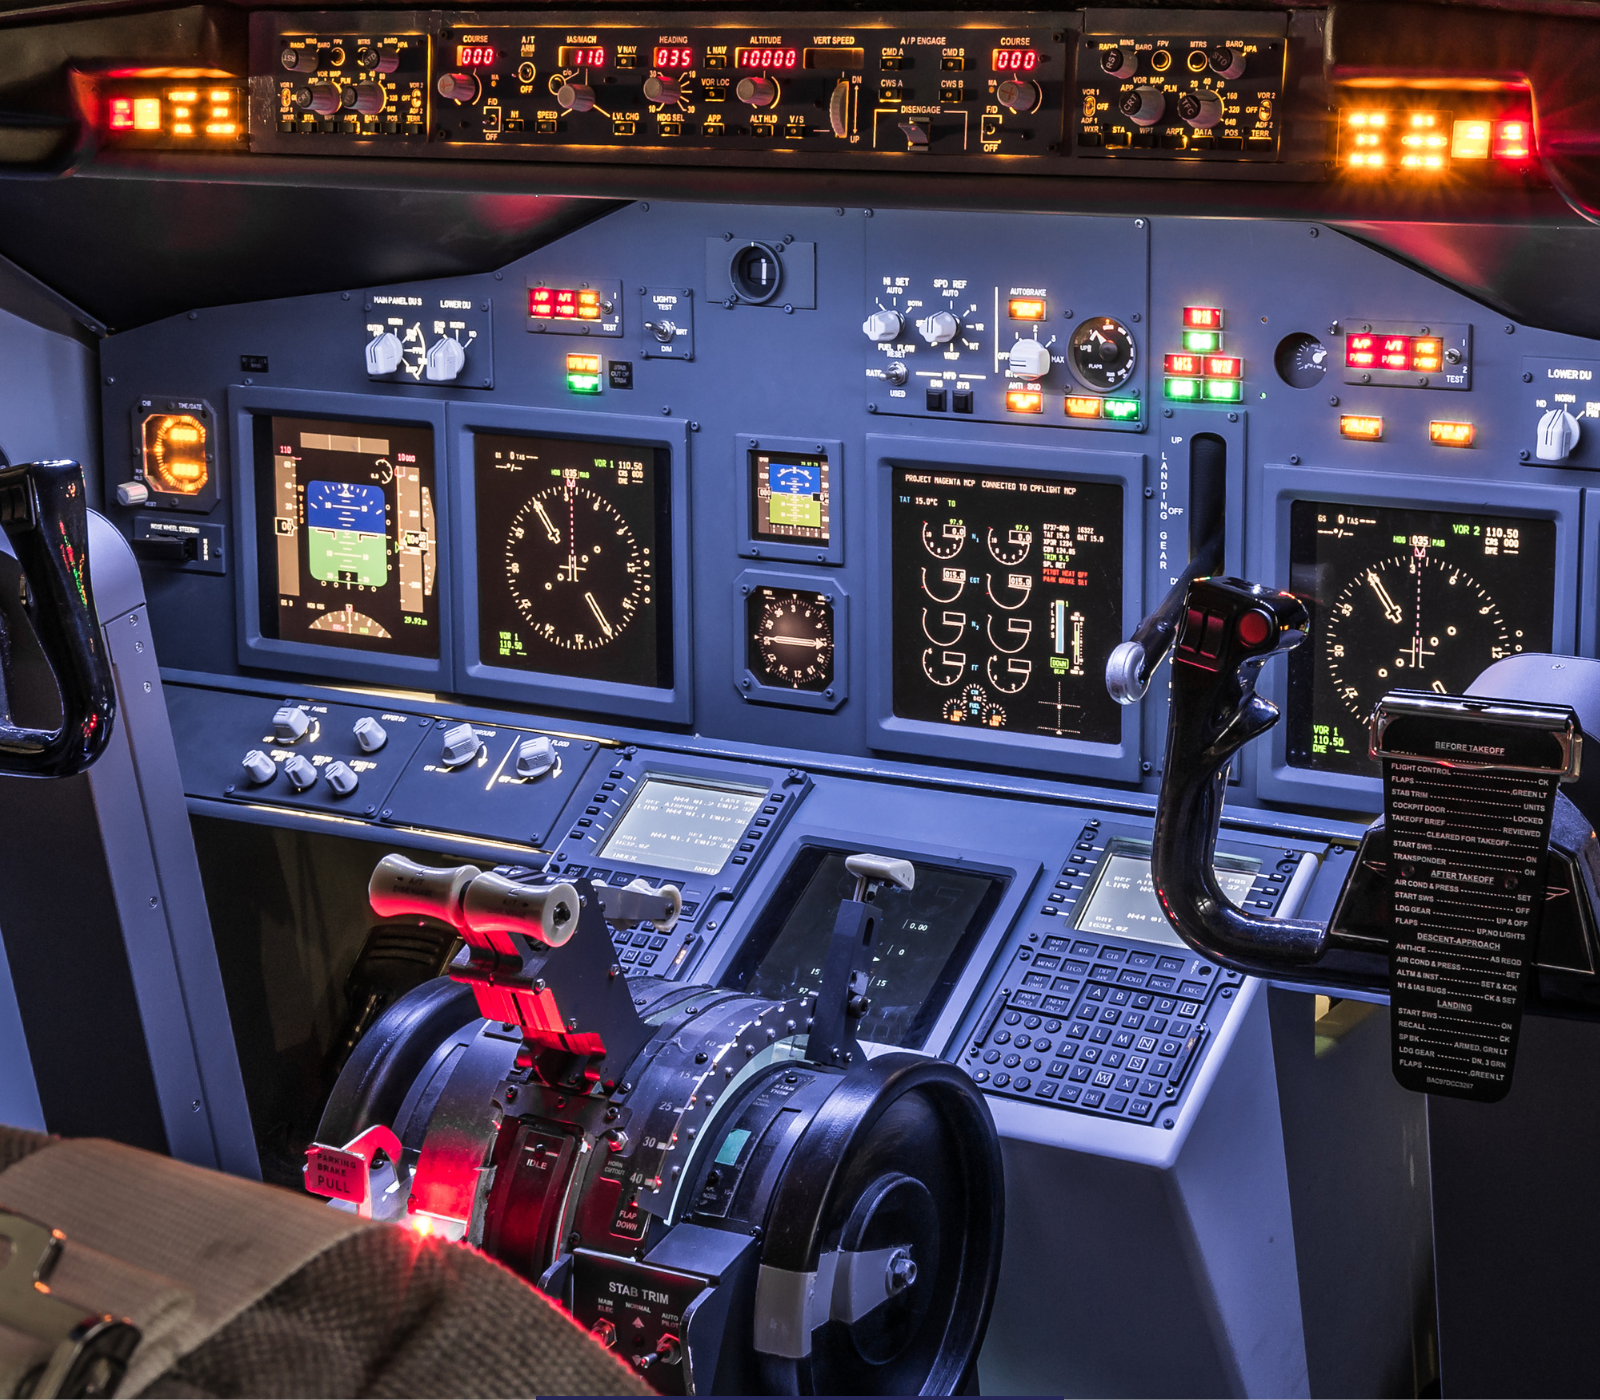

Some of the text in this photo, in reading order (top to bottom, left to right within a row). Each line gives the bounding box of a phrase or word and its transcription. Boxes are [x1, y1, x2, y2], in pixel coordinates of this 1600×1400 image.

[462, 35, 488, 43] COURSE
[521, 36, 535, 44] A/T
[566, 35, 597, 44] IAS/MACH
[659, 36, 688, 44] HEADING
[750, 36, 782, 45] ALTITUDE
[813, 36, 855, 45] VERT SPEED
[917, 37, 946, 45] ENGAGE
[1000, 37, 1030, 45] COURSE
[521, 44, 535, 52] ARM
[1226, 40, 1244, 48] BARO
[623, 46, 637, 54] NAV
[712, 46, 727, 54] NAV
[881, 48, 897, 56] CMD
[942, 48, 965, 57] CMD B
[1244, 45, 1257, 53] HPA
[462, 49, 494, 65] 000
[577, 50, 604, 66] 110
[657, 49, 690, 66] 035
[742, 51, 796, 67] 10000
[997, 51, 1035, 69] 000
[1212, 52, 1227, 66] STD
[689, 70, 696, 78] 10
[701, 78, 730, 86] VOR LOC
[852, 76, 862, 84] DN
[880, 79, 896, 87] CWS
[941, 80, 957, 88] CWS
[1190, 80, 1198, 88] 20
[1203, 77, 1212, 85] 40
[520, 85, 533, 94] OFF
[1227, 92, 1238, 100] 160
[1123, 93, 1137, 111] CRT
[900, 106, 941, 114] DISENGAGE
[986, 105, 998, 113] F/D
[1228, 106, 1240, 114] 320
[537, 111, 558, 119] SPEED
[612, 112, 640, 121] LVL CHG
[657, 114, 685, 122] HDG SEL
[750, 115, 778, 123] ALT HLD
[485, 133, 498, 141] OFF
[983, 144, 998, 152] OFF
[933, 279, 967, 289] SPD REF
[942, 289, 959, 297] AUTO
[1009, 287, 1047, 297] AUTOBRAKE
[440, 300, 461, 308] LOWER
[653, 296, 677, 304] LIGHTS
[1352, 338, 1372, 349] A/P
[1051, 356, 1065, 364] MAX
[1446, 375, 1464, 383] TEST
[1548, 369, 1593, 380] LOWER DU
[1008, 382, 1041, 391] ANTI SKID
[890, 390, 906, 398] USED
[1555, 393, 1576, 403] NORM
[1171, 436, 1183, 444] UP
[594, 459, 643, 470] VOR 1 110.50
[905, 474, 1077, 495] PROJECT MAGENTA MCP CONNECTED TO CPFLIGHT MCP
[1160, 452, 1168, 520] LANDING
[899, 495, 910, 503] TAT
[1168, 507, 1183, 515] OFF
[1453, 524, 1519, 539] VOR 2 110.50
[1411, 535, 1429, 545] 035
[1485, 537, 1519, 548] CRS 000
[1159, 531, 1168, 570] GEAR
[500, 640, 522, 650] 110.50
[1313, 725, 1338, 736] VOR 1
[551, 739, 569, 748] FLOOD
[1313, 735, 1345, 747] 110.50
[1313, 744, 1327, 753] DME
[1435, 741, 1505, 755] BEFORE TAKEOFF
[1391, 763, 1549, 786] FLIGHT CONTROL CK
[1391, 776, 1415, 785] FLAPS
[1391, 788, 1546, 812] STAB TRIM UNITS
[1392, 801, 1544, 825] COCKPIT DOOR LOCKED
[1391, 814, 1541, 838] TAKEOFF BRIEF REVIEWED
[1426, 831, 1510, 847] CLEARED FOR TAKEOFF
[1393, 840, 1416, 849] START
[1416, 843, 1433, 851] SWS
[1393, 852, 1447, 866] TRANSPONDER
[1431, 870, 1495, 884] AFTER TAKEOFF
[1105, 881, 1130, 890] LIPR
[909, 922, 928, 931] 0.00
[1395, 917, 1419, 927] FLAPS
[1499, 931, 1526, 941] LIGHTS
[1417, 932, 1501, 951] DESCENT-APPROACH
[1395, 943, 1522, 967] ANTI-ICE AS REQD
[1036, 959, 1056, 968] MENU
[1122, 974, 1142, 985] HOLD
[1150, 979, 1170, 989] PROG
[1092, 988, 1102, 997] A
[1116, 992, 1124, 1001] B
[1437, 1000, 1473, 1012] LANDING
[1398, 1020, 1427, 1031] RECALL
[1085, 1050, 1096, 1060] Q
[1399, 1059, 1423, 1069] FLAPS
[658, 1101, 672, 1111] 25
[642, 1136, 656, 1148] 30
[317, 1153, 356, 1169] PARKING
[526, 1158, 547, 1170] IDLE
[317, 1163, 347, 1177] BRAKE
[629, 1172, 643, 1185] 40
[317, 1175, 350, 1193] PULL
[619, 1210, 637, 1220] FLAP
[616, 1220, 638, 1231] DOWN
[608, 1281, 669, 1305] STAB TRIM
[625, 1302, 651, 1314] NORMAL
[661, 1313, 679, 1321] AUTO
[661, 1320, 679, 1329] PILOT
